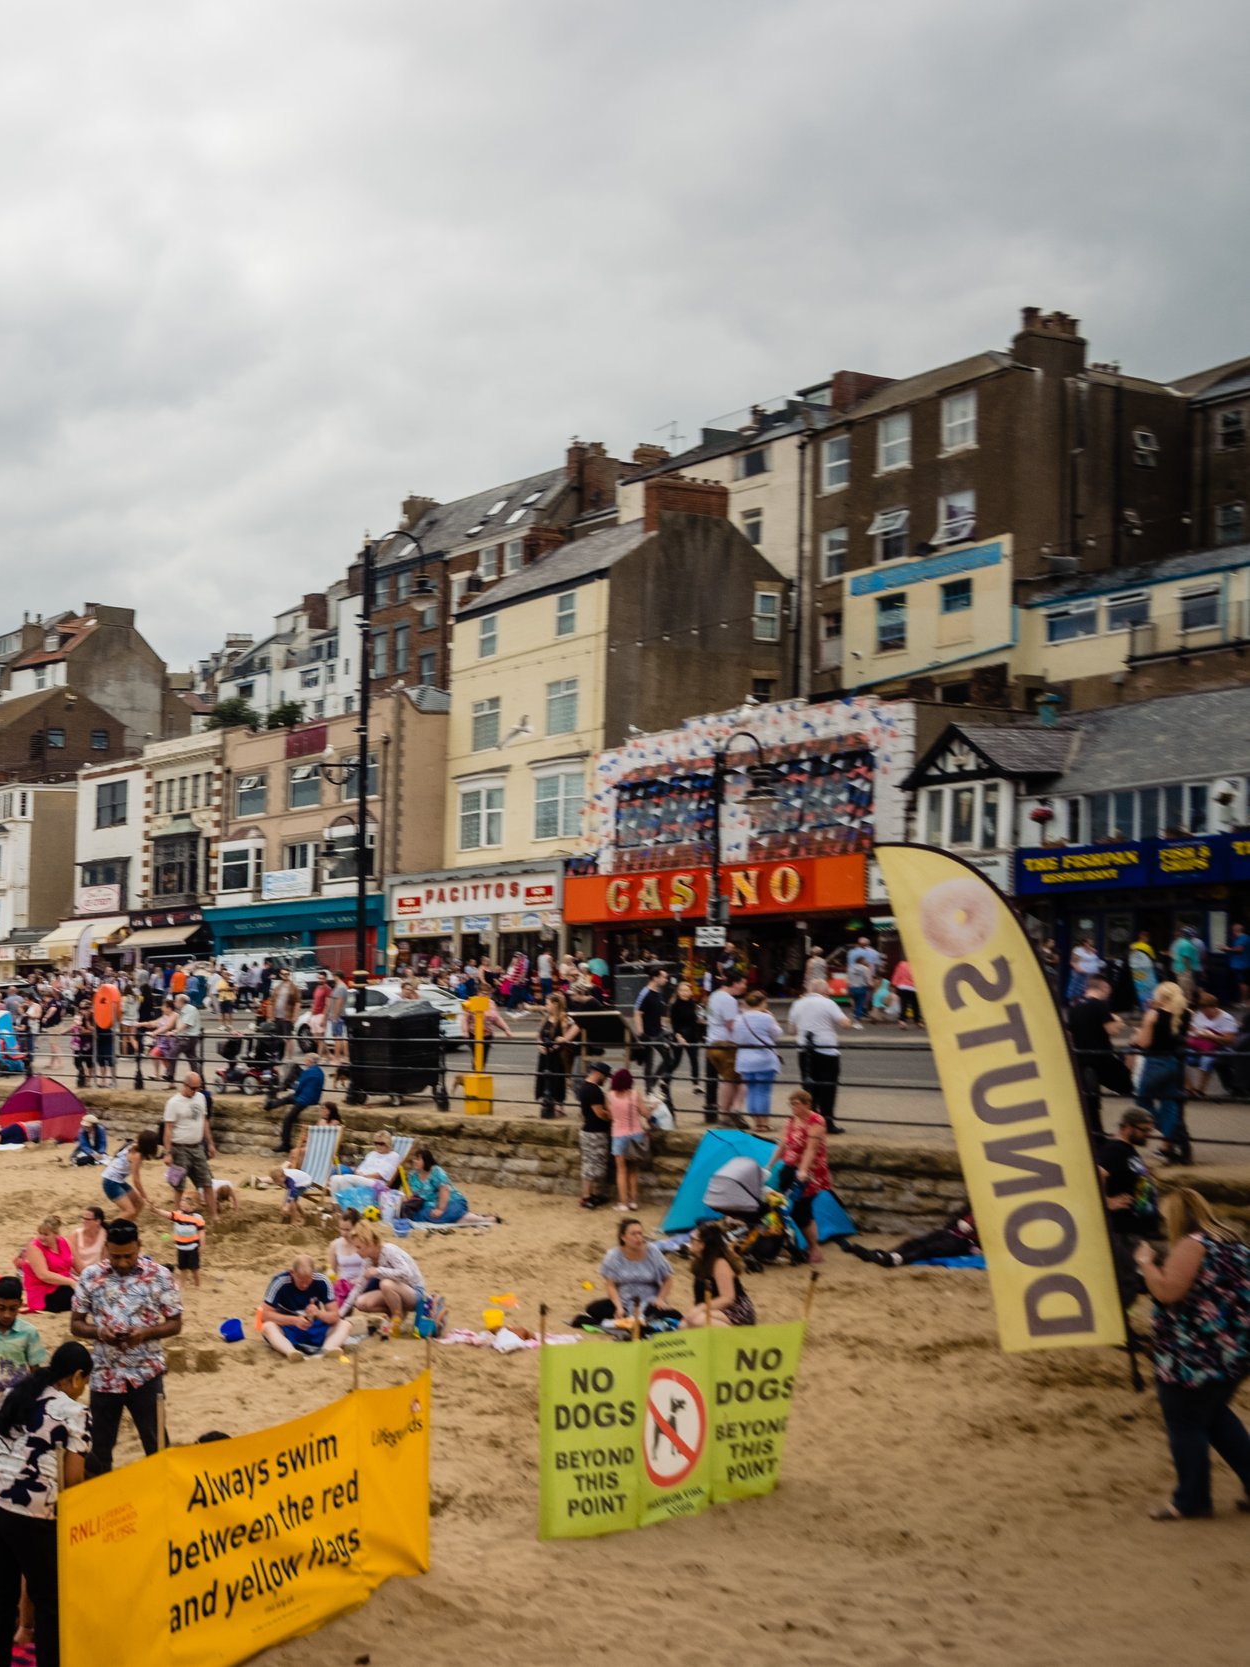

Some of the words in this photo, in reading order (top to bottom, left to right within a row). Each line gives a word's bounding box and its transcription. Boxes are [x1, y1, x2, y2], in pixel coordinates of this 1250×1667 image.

[1023, 857, 1058, 871] THE
[425, 881, 520, 904] PACITTOS
[735, 1347, 783, 1371] NO
[571, 1367, 614, 1394] NO
[715, 1375, 795, 1405] DOGS
[554, 1401, 636, 1430] DOGS
[555, 1446, 635, 1471] BEYOND
[729, 1438, 774, 1461] THIS
[187, 1457, 270, 1513] Always
[276, 1433, 338, 1478] swim
[574, 1471, 619, 1493] THIS
[726, 1457, 779, 1484] POINT
[567, 1493, 627, 1518] POINT
[70, 1515, 101, 1547] RNLI
[169, 1512, 279, 1577] between
[278, 1494, 314, 1531] the
[322, 1469, 359, 1514] red
[170, 1579, 218, 1634] and
[225, 1552, 304, 1619] yellow
[307, 1528, 361, 1571] flags
